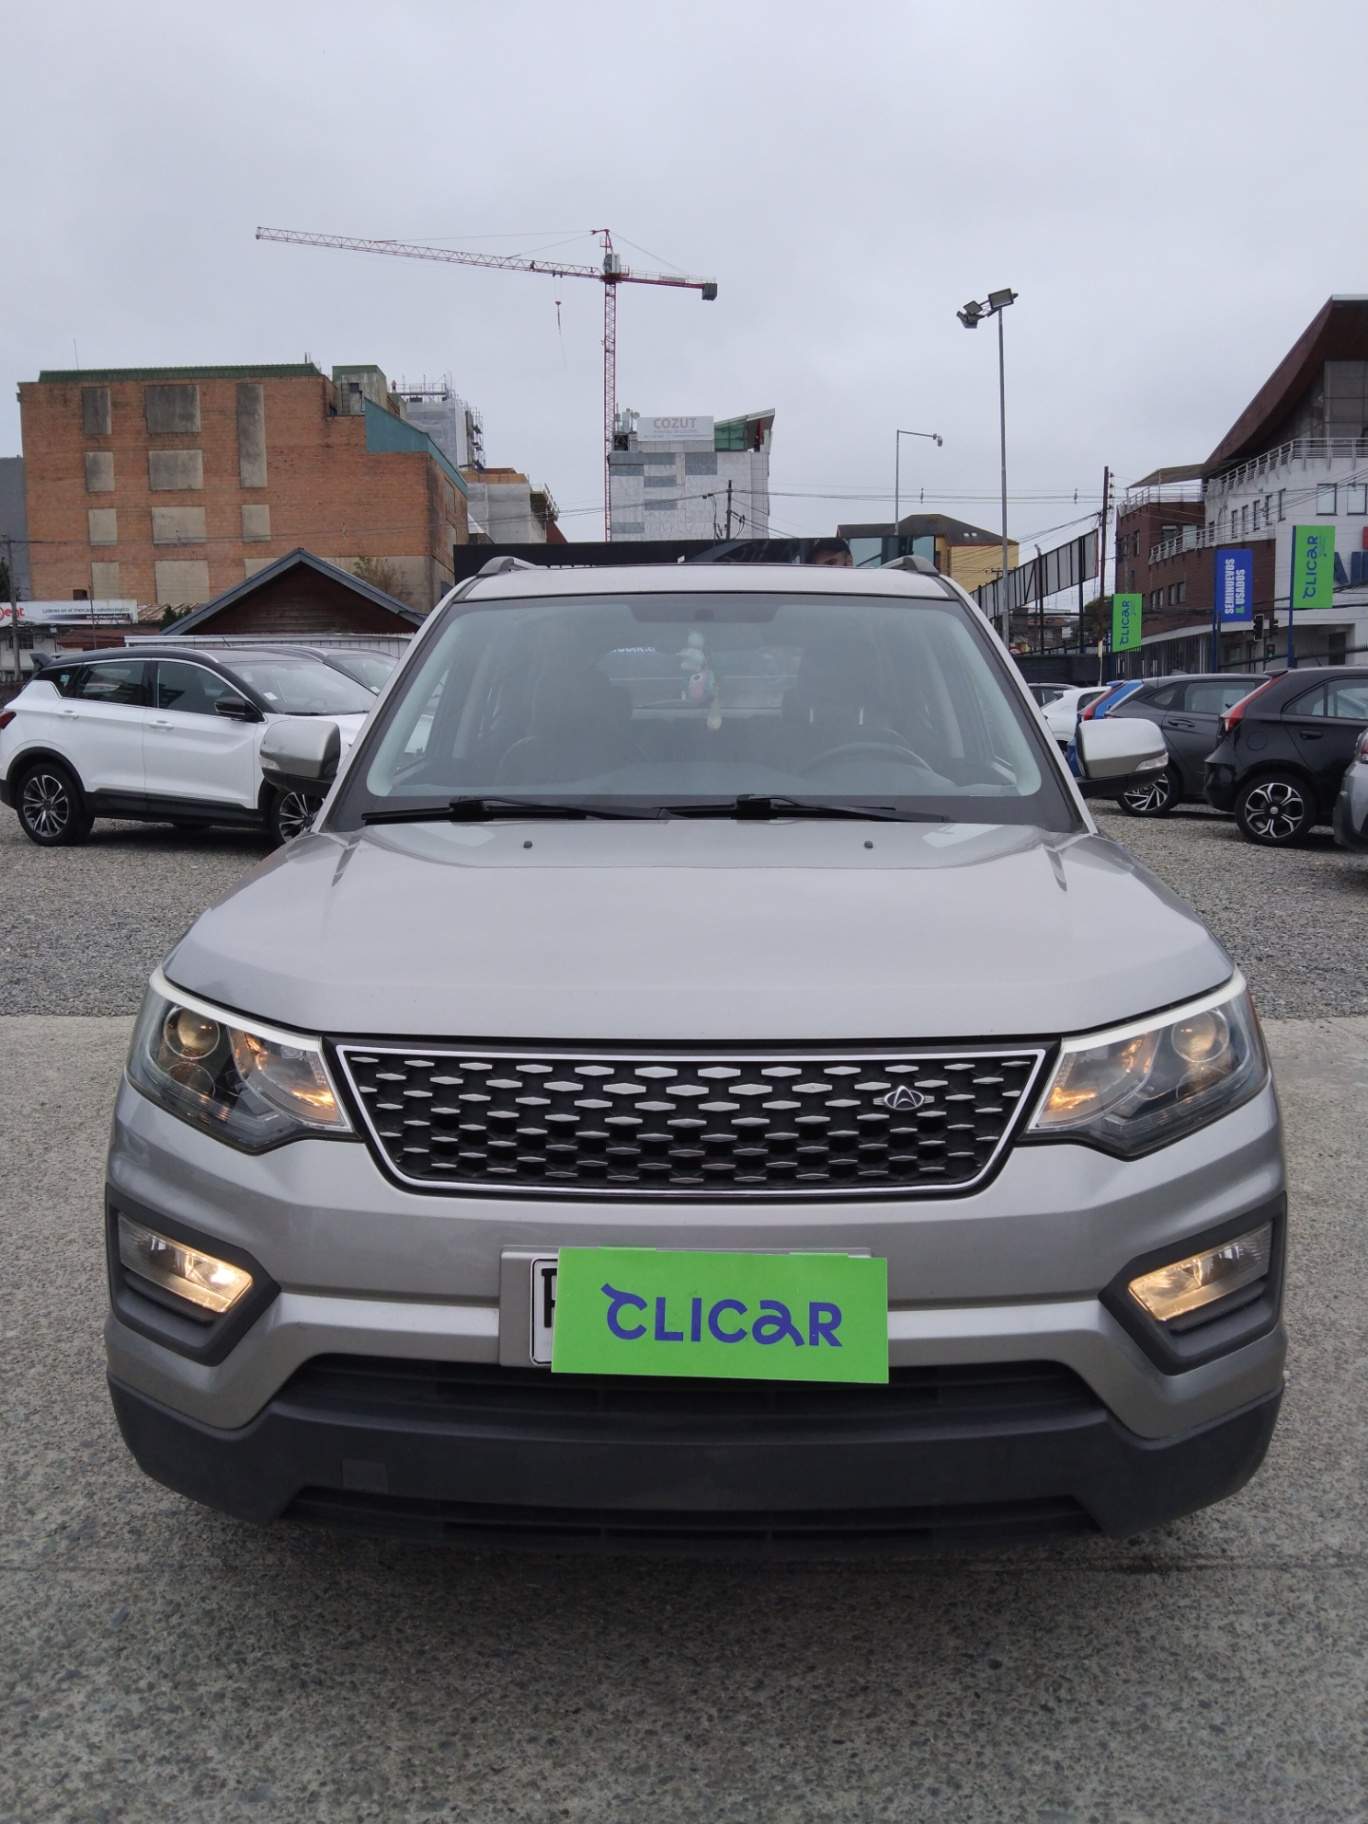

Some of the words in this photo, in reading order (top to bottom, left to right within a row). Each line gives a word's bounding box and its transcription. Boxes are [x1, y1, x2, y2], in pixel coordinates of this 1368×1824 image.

[654, 416, 697, 429] COZUT
[1224, 558, 1235, 614] SEMINUEVOS
[1235, 569, 1246, 604] USADOS
